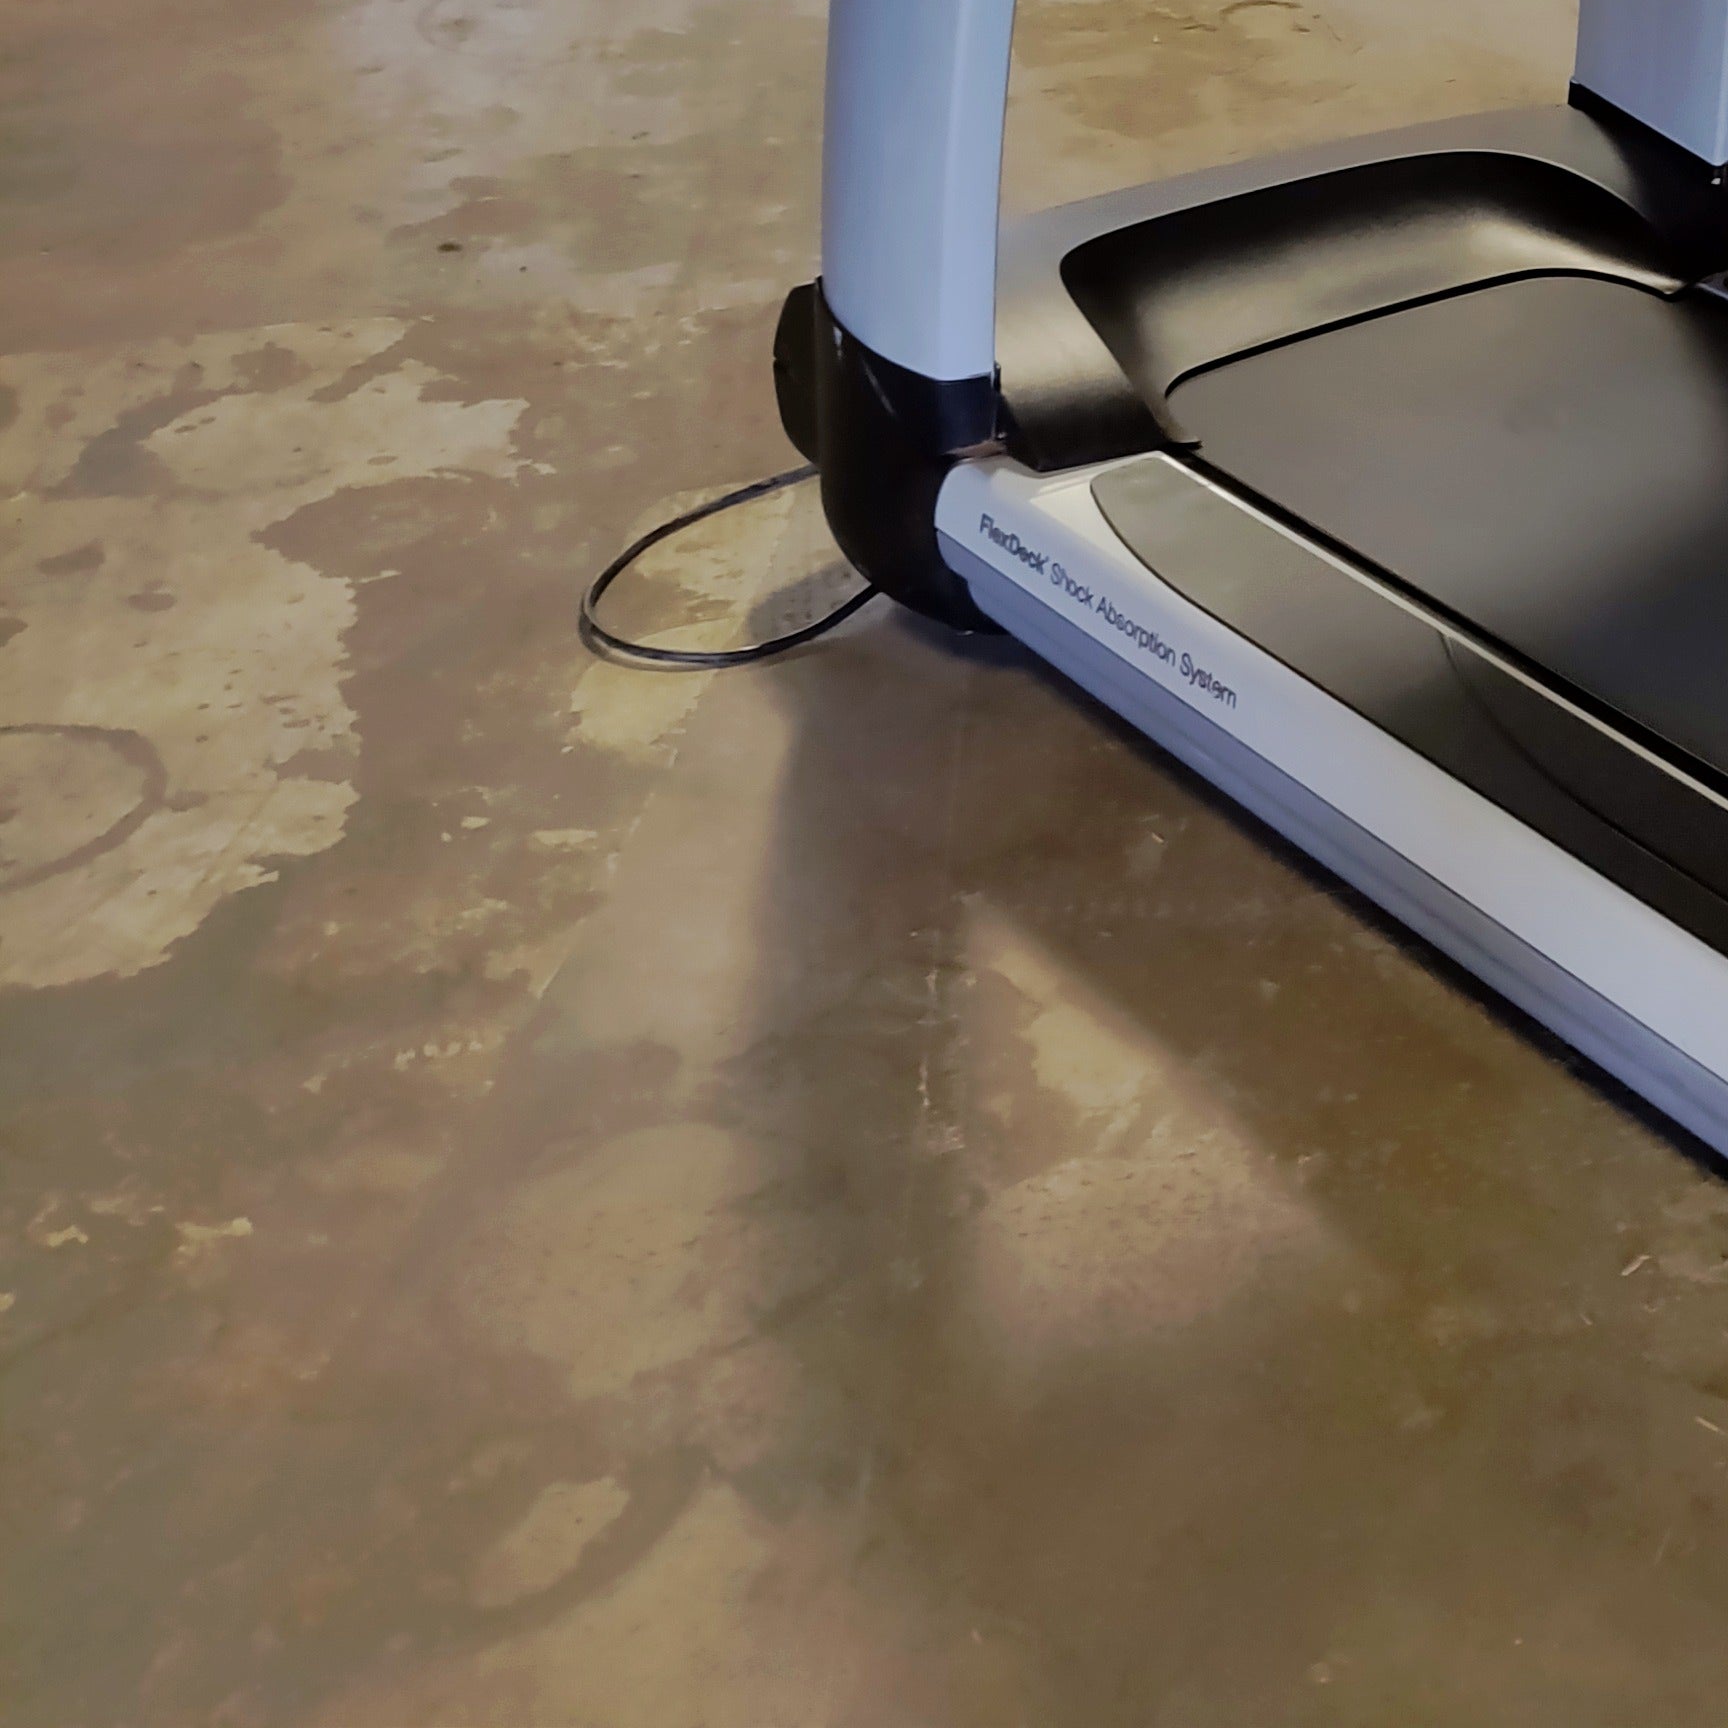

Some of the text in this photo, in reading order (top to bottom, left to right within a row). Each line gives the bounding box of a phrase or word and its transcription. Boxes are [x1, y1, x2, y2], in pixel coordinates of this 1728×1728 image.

[1051, 562, 1094, 610] Shock
[1096, 597, 1176, 667] Absorption
[1180, 653, 1237, 709] System
